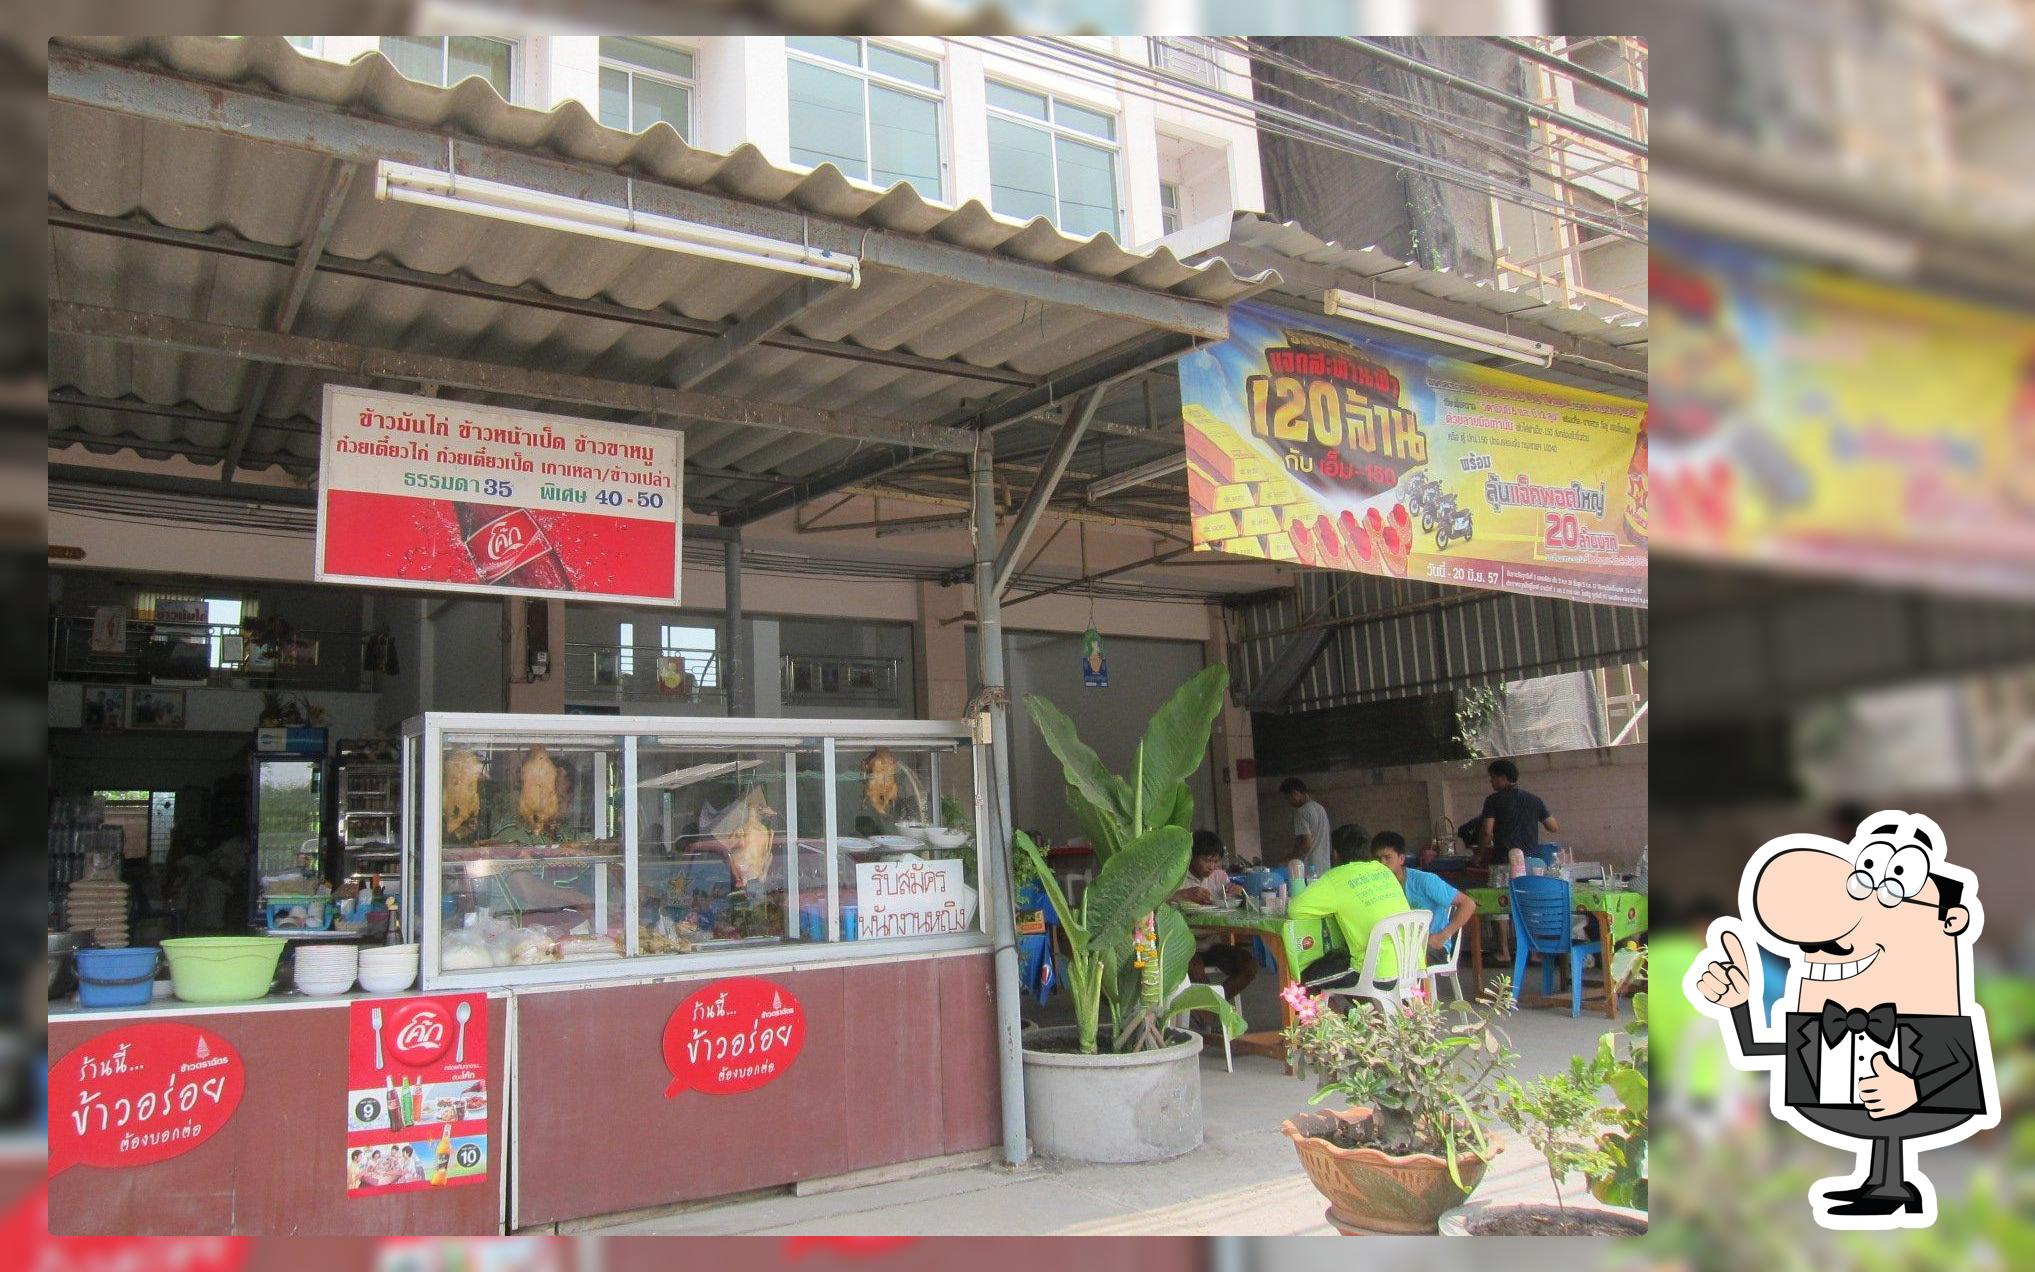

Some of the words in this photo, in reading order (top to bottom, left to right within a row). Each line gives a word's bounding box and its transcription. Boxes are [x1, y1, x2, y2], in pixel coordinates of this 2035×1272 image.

[360, 408, 449, 437] ข้าวมันไก่
[459, 420, 566, 450] ข้าวหน้าเป็ด
[575, 435, 654, 467] ข้าวขาหมู
[336, 435, 429, 461] ก๋วยเตี๋ยวไก่
[437, 446, 534, 472] ก๋วยเตี๋ยวเป็ด
[542, 462, 671, 488] เกาเหลา/ข้าวเปล่า
[1285, 448, 1313, 473] กับ
[1460, 453, 1491, 471] พร้อม
[404, 472, 480, 492] ธรรมดา
[483, 478, 513, 498] 35
[540, 482, 588, 503] พิเศษ
[595, 489, 623, 507] 40
[637, 491, 664, 509] 50
[1545, 512, 1578, 548] 20
[1453, 568, 1464, 580] 20
[1467, 568, 1485, 583] มิ.ย.
[1487, 572, 1498, 584] 57
[871, 863, 946, 896] รับสมัคร
[859, 901, 966, 937] พนักงานหญิง
[687, 1018, 793, 1064] ข้าวอร่อย
[79, 1043, 145, 1082] ร้านนี้...
[180, 1056, 229, 1073] ข้าวตราฉัตร
[718, 1059, 775, 1082] ต้องบอกต่อ
[71, 1073, 226, 1136] ข้าวอร่อย
[363, 1104, 374, 1118] 9
[119, 1119, 202, 1152] ต้องบอกต่อ
[460, 1150, 477, 1164] 10
